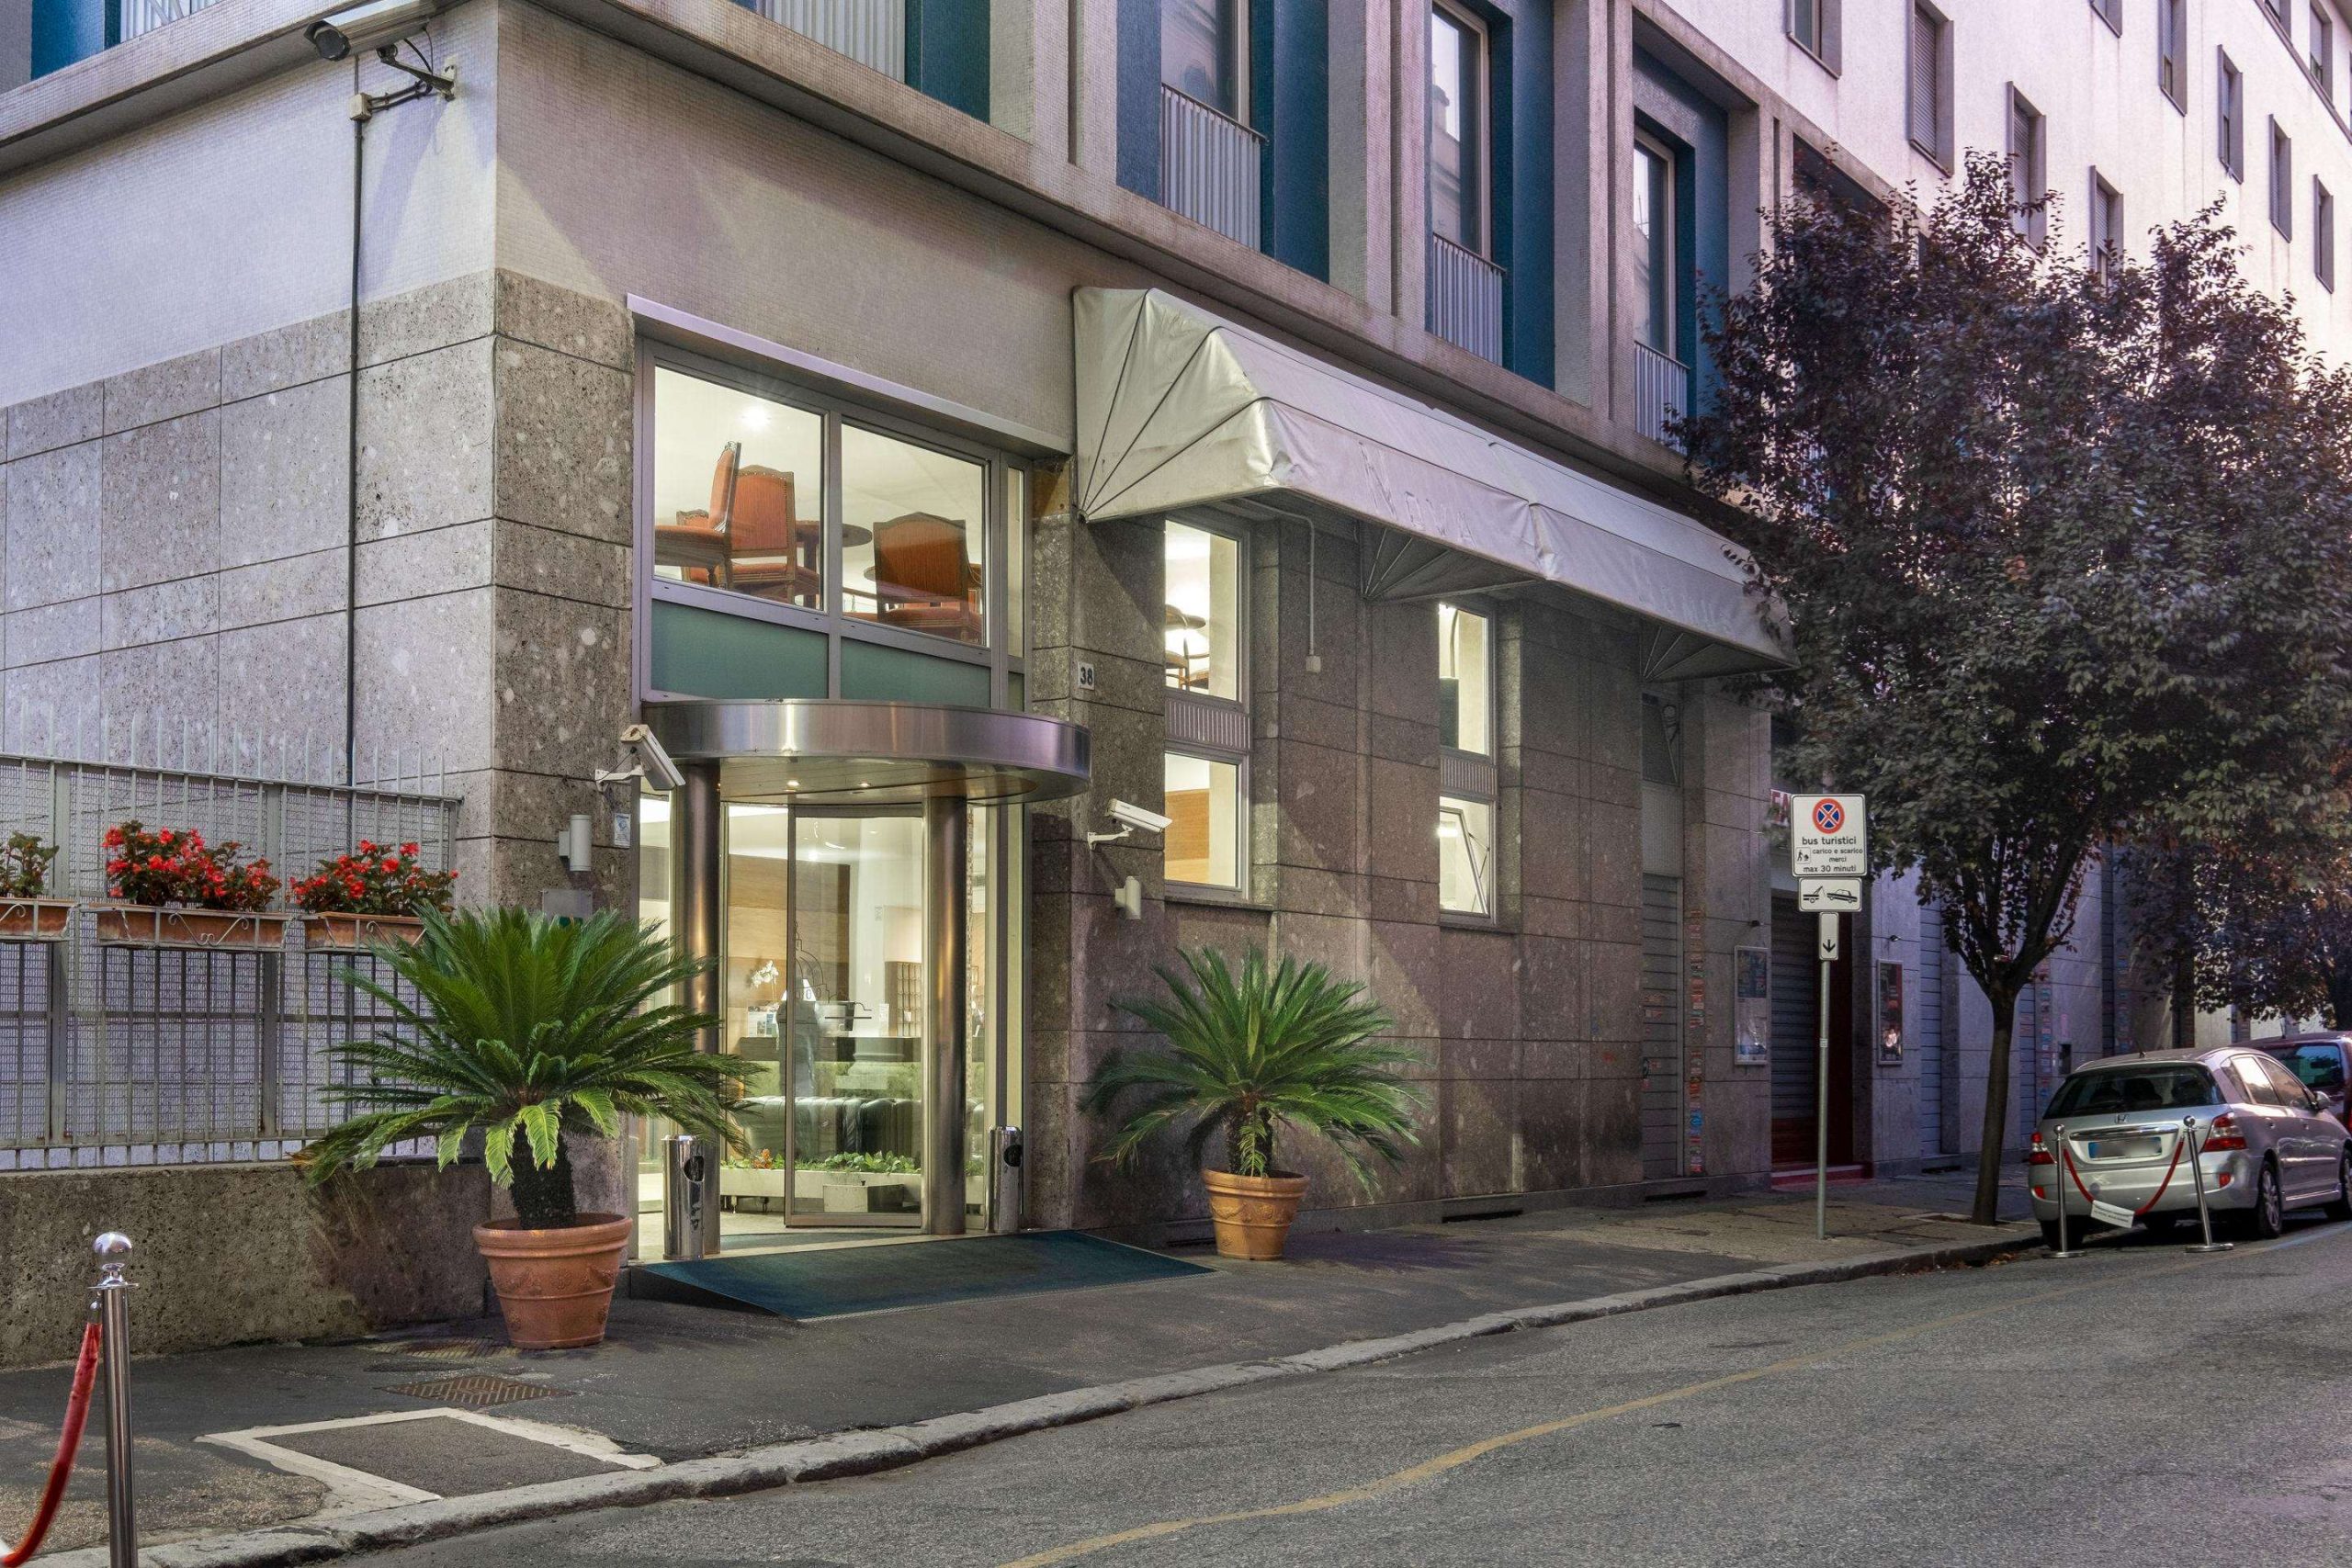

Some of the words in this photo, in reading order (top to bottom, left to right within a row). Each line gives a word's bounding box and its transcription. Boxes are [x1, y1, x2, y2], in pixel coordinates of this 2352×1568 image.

[1080, 667, 1092, 685] 38
[1802, 837, 1818, 845] bus
[1821, 837, 1857, 845] turistici
